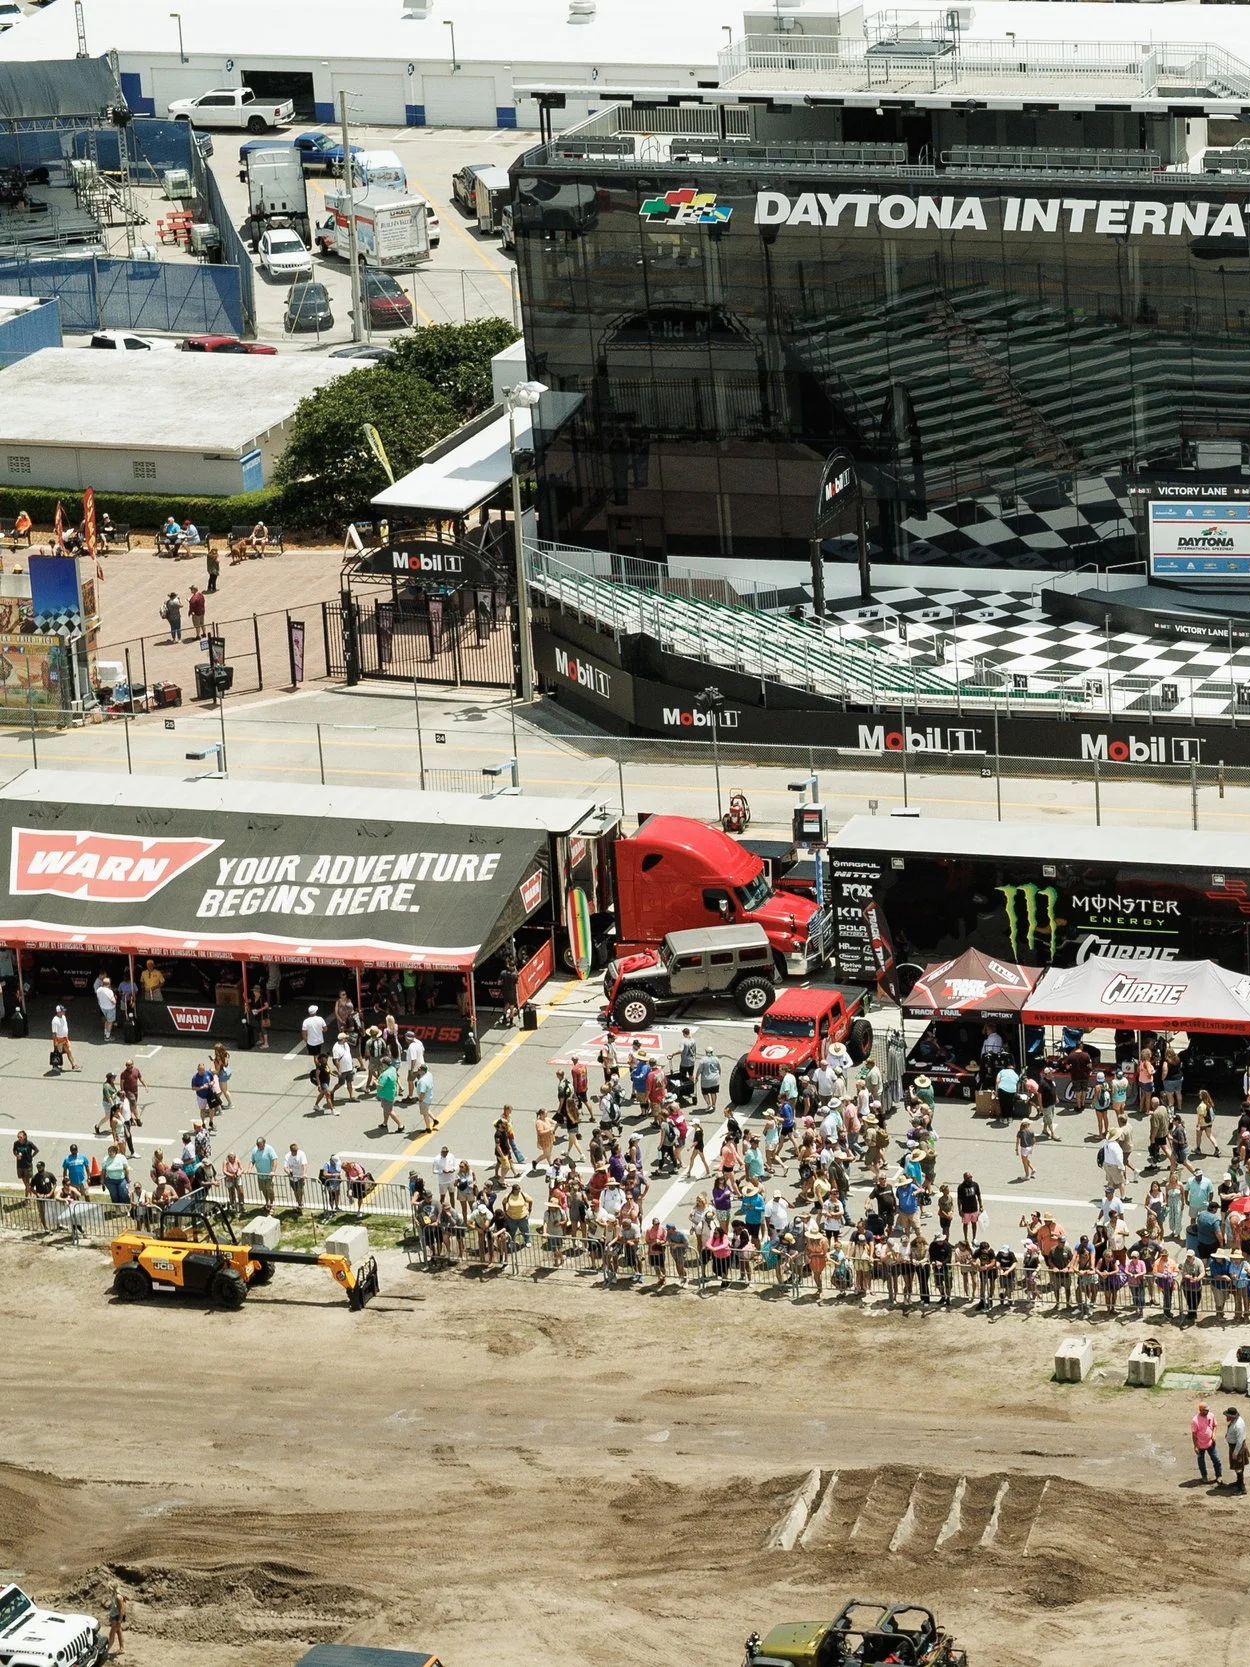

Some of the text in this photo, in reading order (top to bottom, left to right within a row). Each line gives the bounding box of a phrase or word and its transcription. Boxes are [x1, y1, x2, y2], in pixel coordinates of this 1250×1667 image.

[754, 191, 987, 230] DAYTONA
[826, 473, 844, 501] Mobil
[1158, 487, 1227, 496] VICTORY LANE
[1178, 537, 1234, 547] DAYTONA
[393, 552, 442, 571] Mobil
[1175, 624, 1207, 635] VICTORY
[1208, 628, 1229, 637] LANE
[555, 647, 594, 690] Mobil
[165, 721, 175, 729] 25
[436, 734, 445, 742] 24
[858, 724, 941, 751] Mobil
[1081, 733, 1166, 762] Mobil
[27, 851, 170, 882] WARN
[216, 852, 501, 886] YOUR ADVENTURE
[840, 861, 880, 869] MAGPUL
[834, 871, 880, 879] NITTO
[196, 883, 420, 917] BEGINS HERE.
[842, 883, 873, 902] FOX
[1072, 894, 1181, 916] MONSTER
[1090, 916, 1164, 926] ENERGY
[945, 979, 987, 989] TRACK
[1101, 973, 1187, 1005] CURRIE
[176, 1012, 207, 1025] WARN
[909, 1008, 961, 1017] TRACK TRAIL
[154, 1263, 175, 1271] JCB
